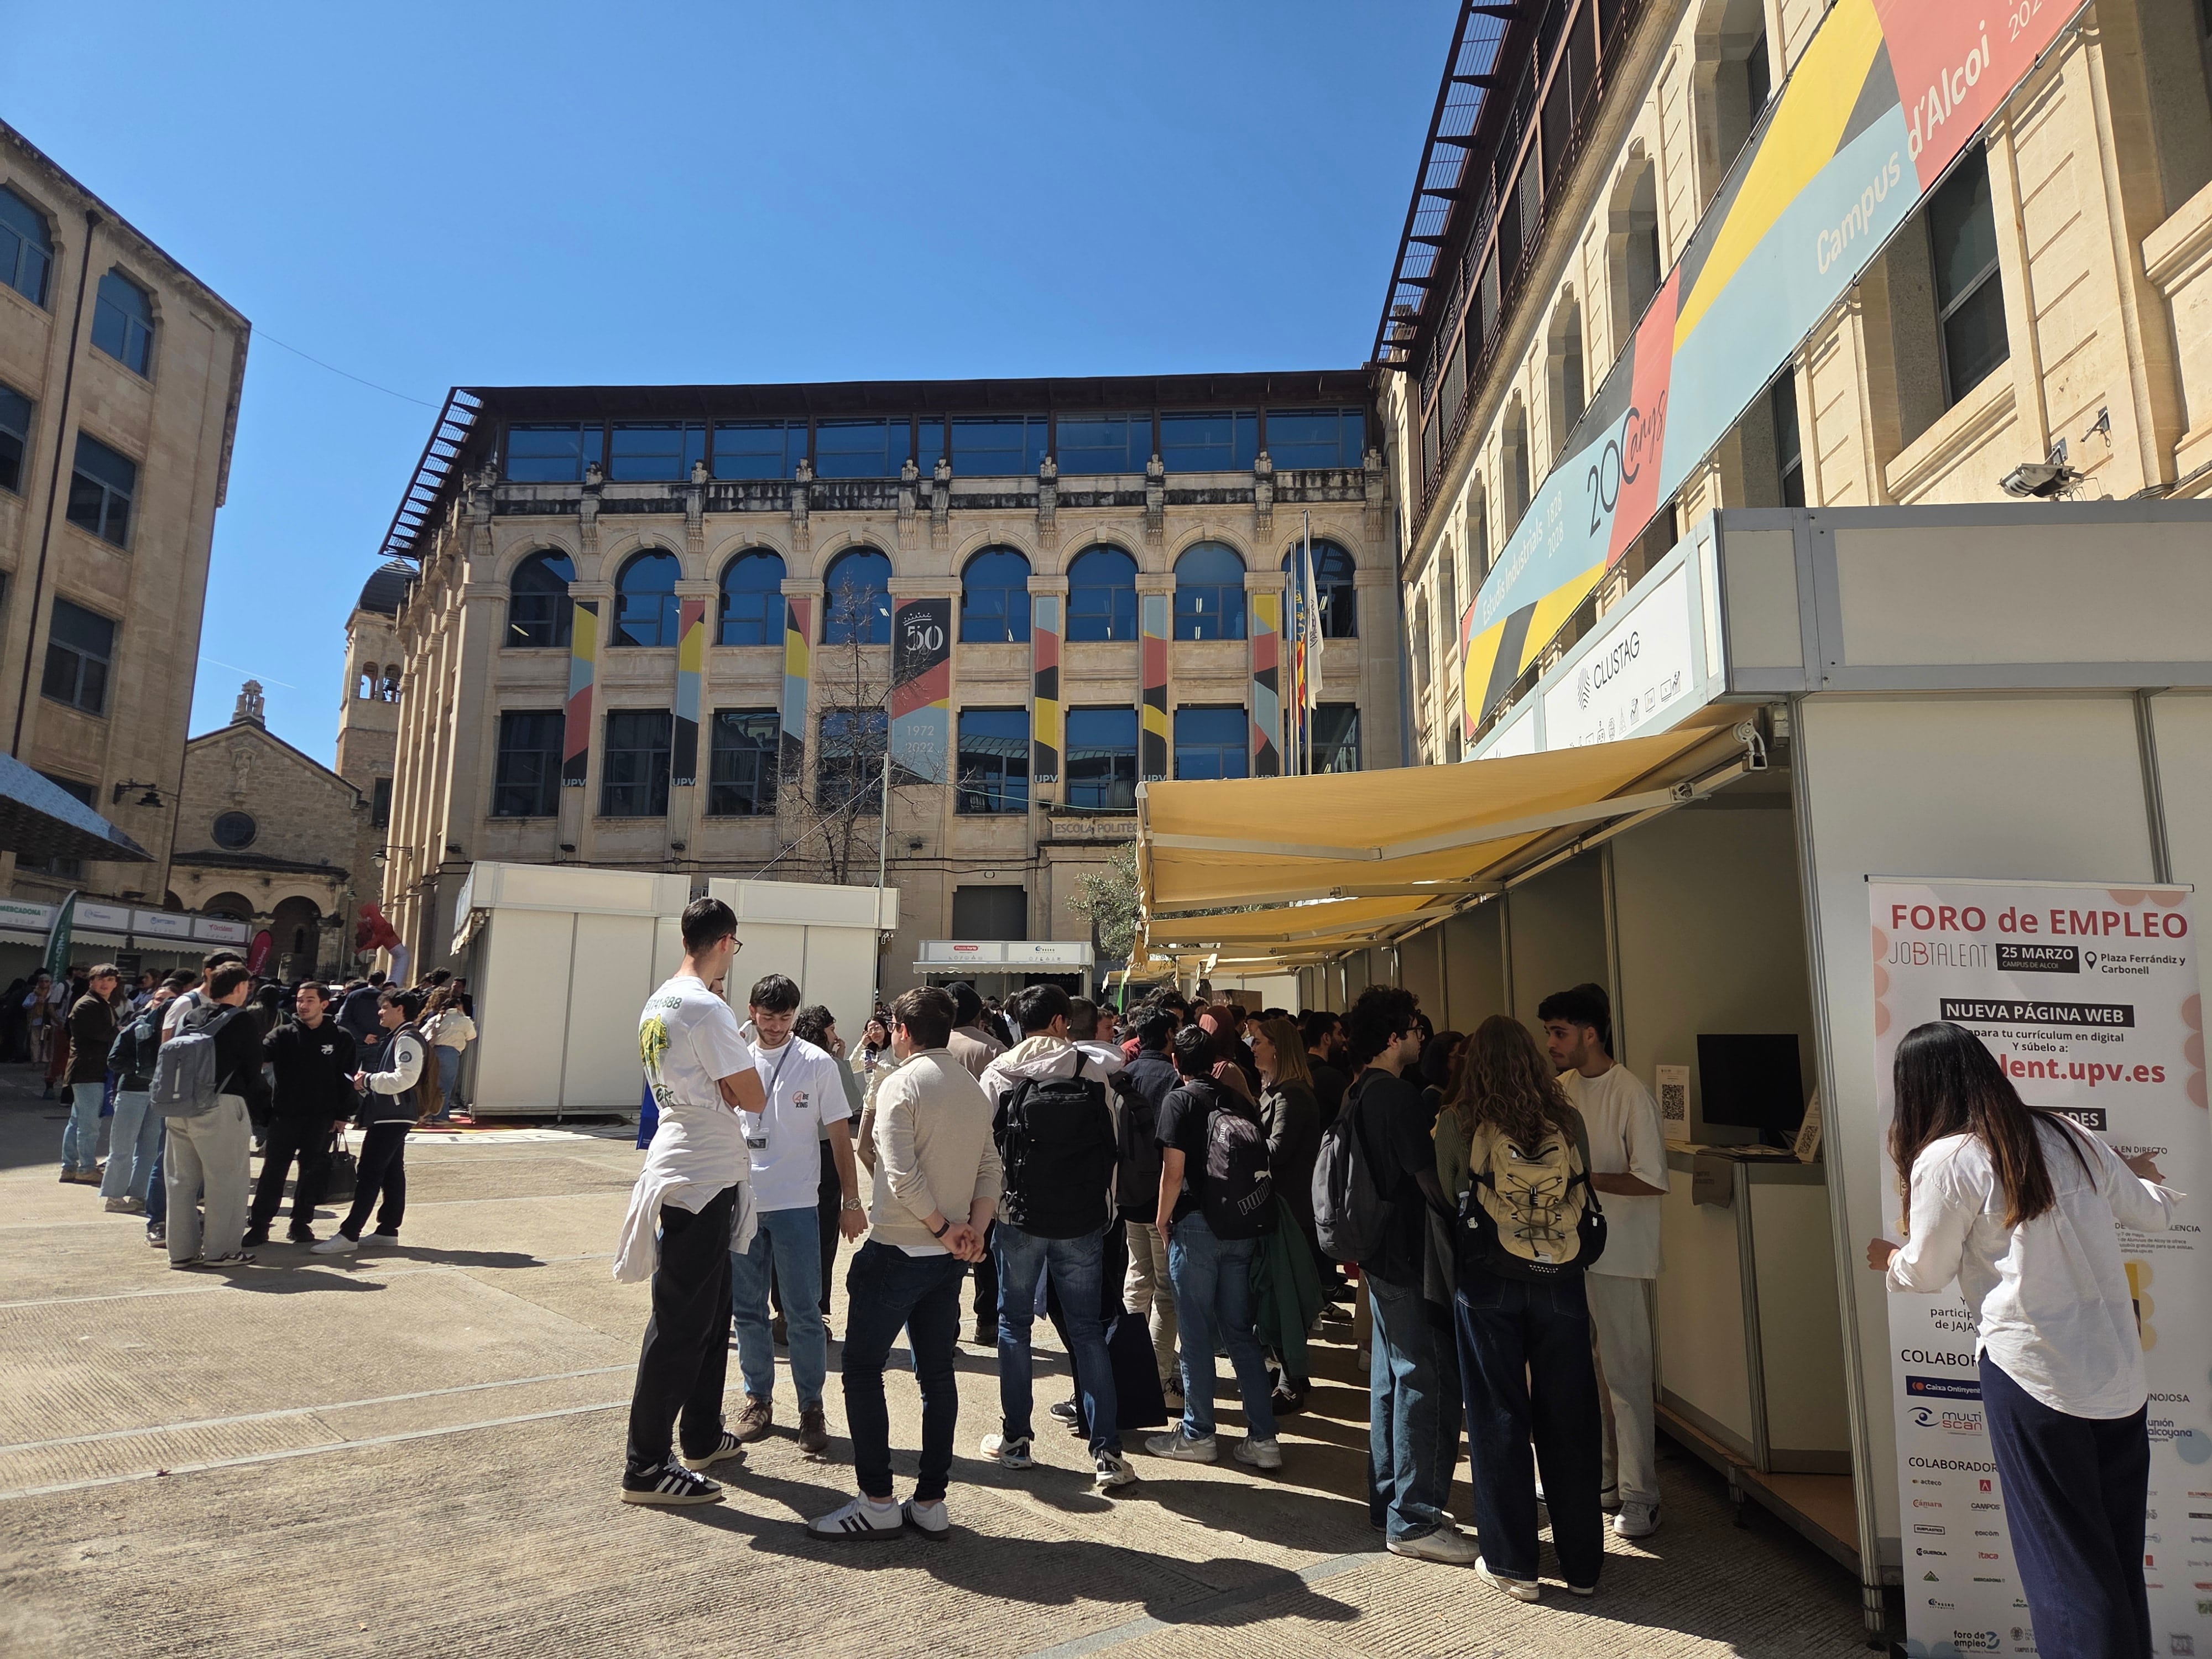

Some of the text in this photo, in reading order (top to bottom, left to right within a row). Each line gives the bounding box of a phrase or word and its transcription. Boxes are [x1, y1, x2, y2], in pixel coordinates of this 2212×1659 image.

[2008, 0, 2042, 43] 202
[1817, 19, 1990, 275] Campus d'Alcoi
[1547, 490, 1562, 528] 1828
[1547, 521, 1564, 559] 2028
[1482, 517, 1543, 627] Estudis Industrials
[906, 625, 943, 651] 50
[1594, 631, 1640, 690] CLUSTAG
[906, 725, 934, 737] 1972
[905, 742, 934, 753] 2022
[562, 778, 586, 787] UPV
[672, 778, 696, 786] UPV
[1034, 774, 1058, 783] UPV
[1055, 821, 1138, 834] ESCOLA POLITÈC
[1891, 904, 2188, 938] FORO de EMPLEO
[1888, 941, 1988, 968] JOBTALENT
[2001, 946, 2074, 961] 25 MARZO
[2100, 953, 2186, 967] Plaza Ferrándiz y
[2101, 964, 2150, 975] Carbonell
[1946, 1003, 2124, 1023] NUEVA PÁGINA WEB
[2001, 1030, 2013, 1038] tu
[2016, 1030, 2073, 1040] currículum
[2075, 1032, 2088, 1041] en
[2090, 1032, 2124, 1044] digital
[2012, 1042, 2069, 1052] Y súbelo a:
[2000, 1053, 2166, 1088] lent.upv.es
[2133, 1146, 2168, 1155] DIRECTO
[2168, 1224, 2201, 1233] LENCIA
[1930, 1307, 1973, 1319] particip
[1935, 1320, 1976, 1333] de JAJA
[1901, 1349, 1978, 1367] COLABO
[2147, 1393, 2190, 1403] INOJOSA
[2147, 1417, 2174, 1427] unión
[2147, 1427, 2193, 1439] alcoyana
[1908, 1457, 1999, 1473] COLABORADOR
[1913, 1499, 1943, 1508] Cámara
[1954, 1630, 1972, 1639] foro
[1954, 1639, 1986, 1649] empleo
